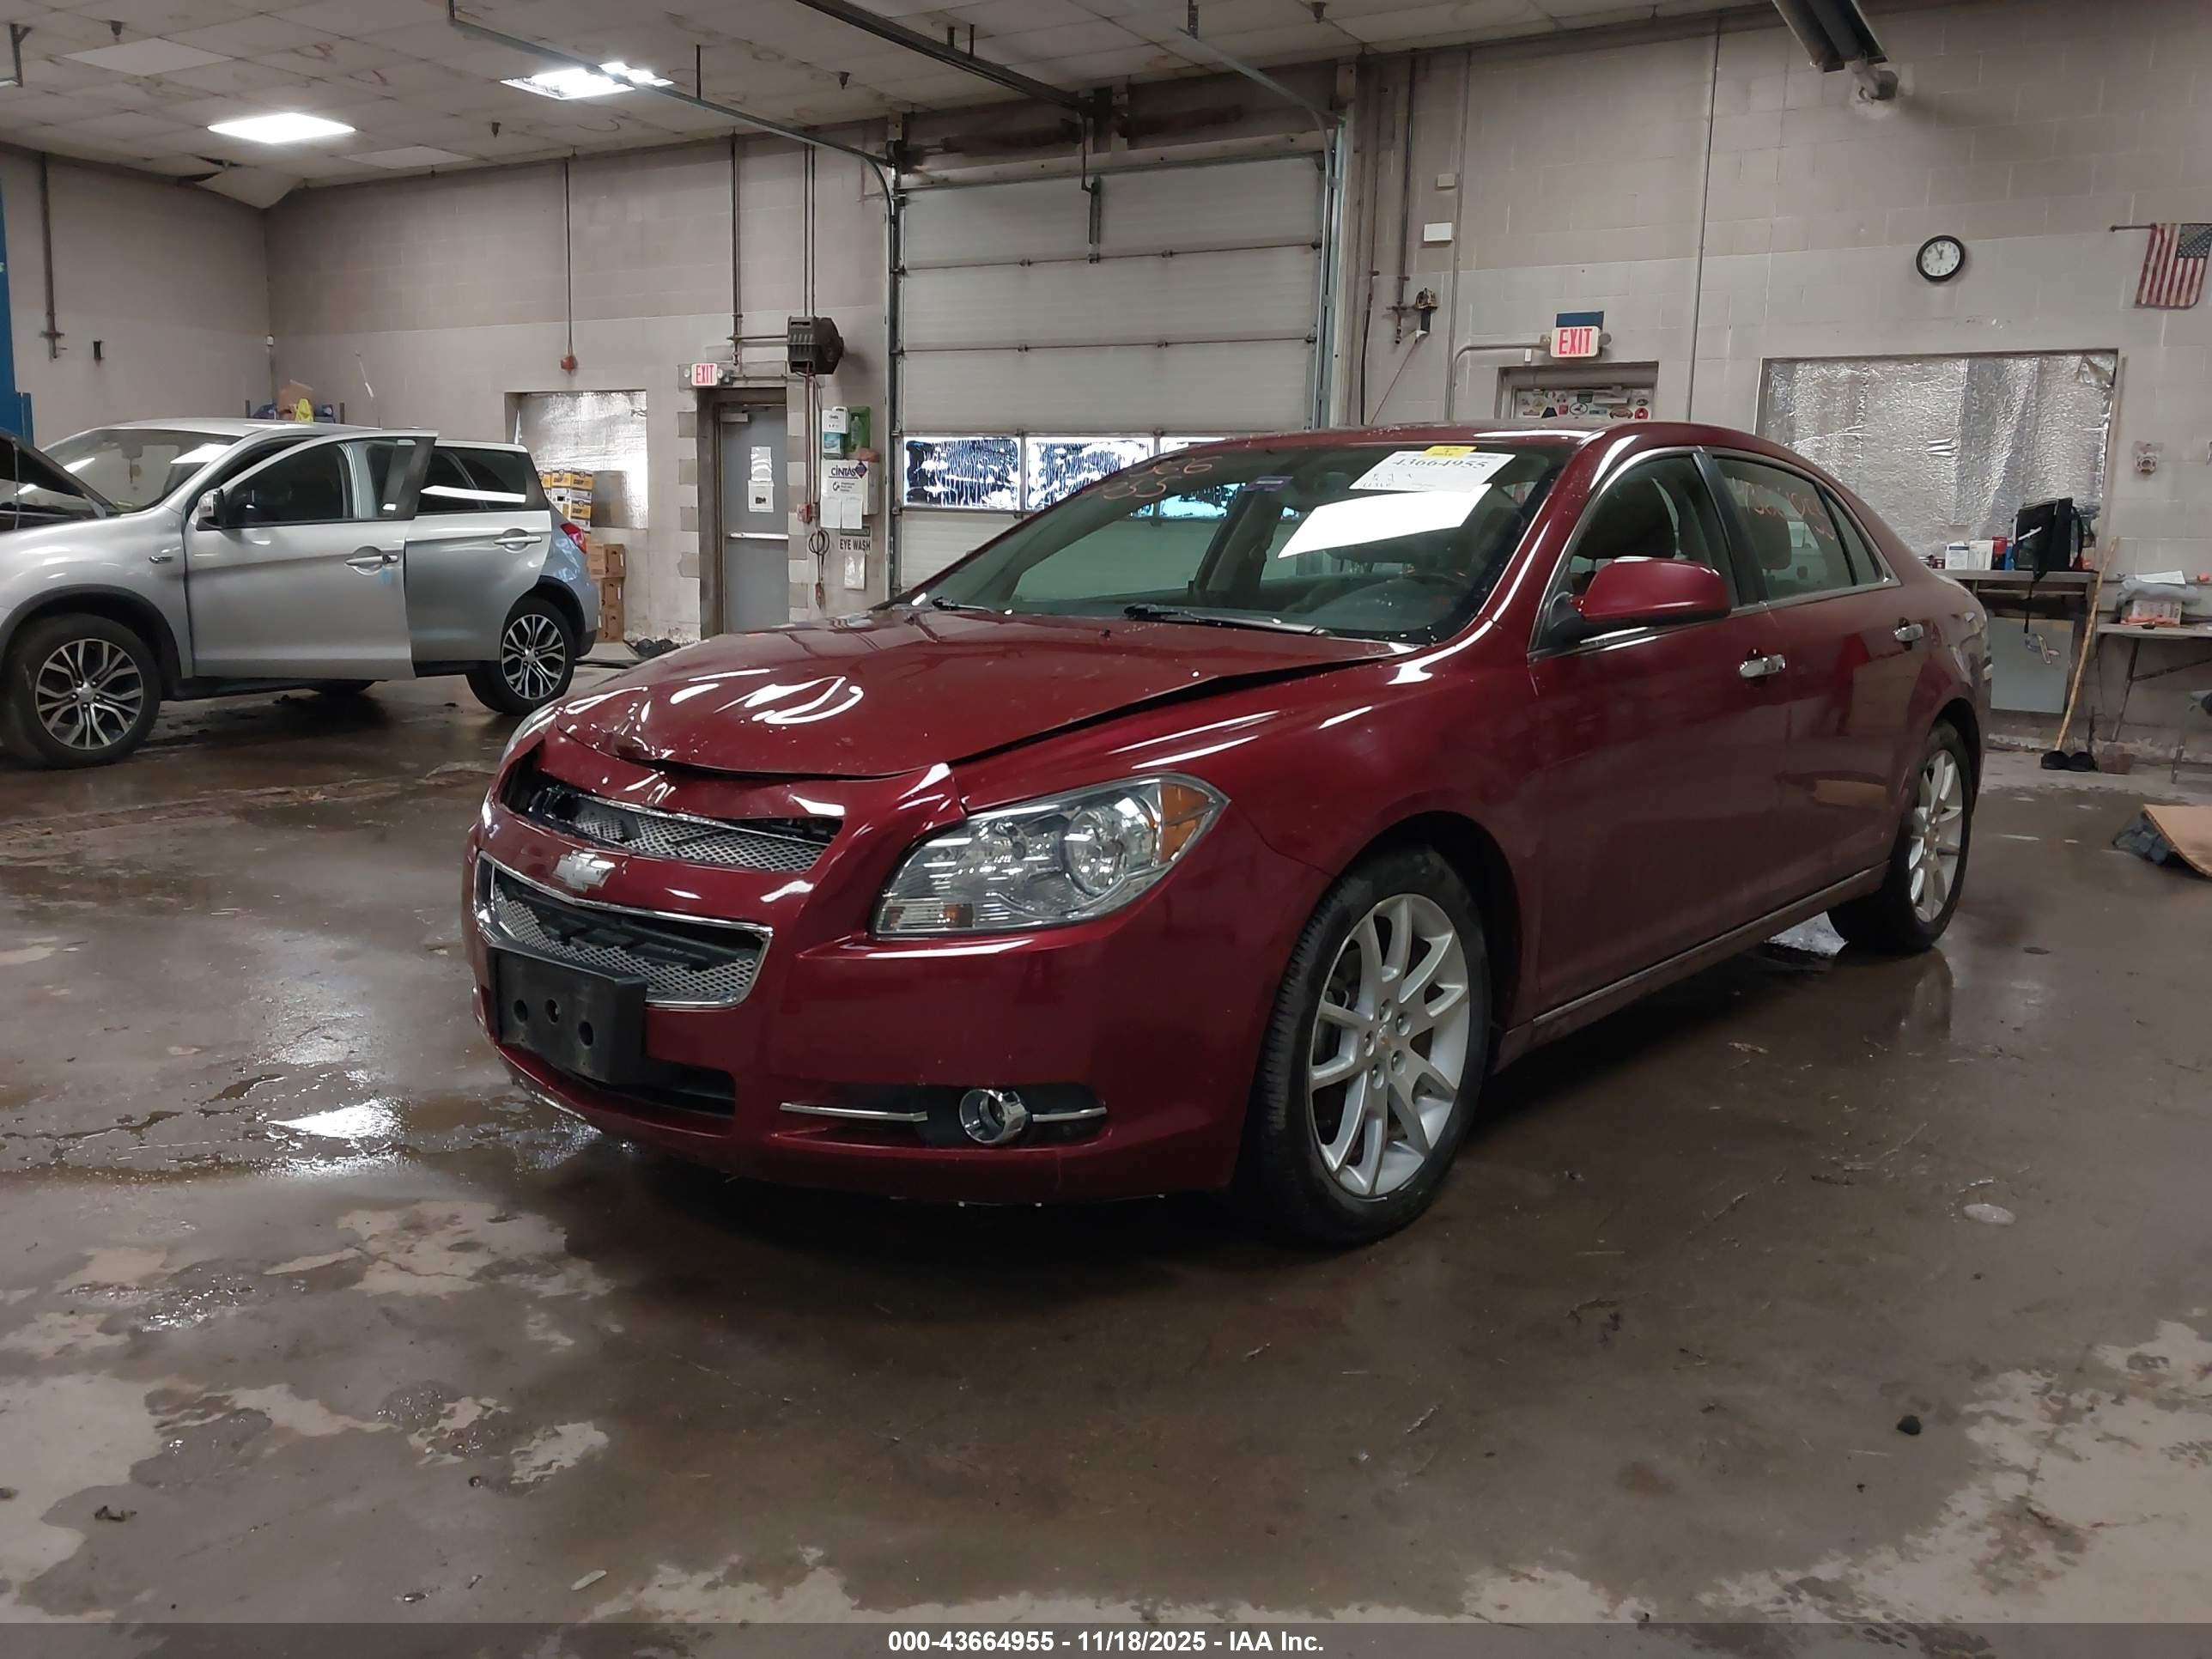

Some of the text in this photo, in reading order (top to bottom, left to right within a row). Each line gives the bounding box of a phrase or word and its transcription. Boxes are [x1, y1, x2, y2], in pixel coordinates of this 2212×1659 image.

[1559, 328, 1593, 356] EXIT
[696, 364, 714, 384] EXIT
[830, 465, 857, 477] CINTAS
[839, 538, 871, 551] EYE WASH
